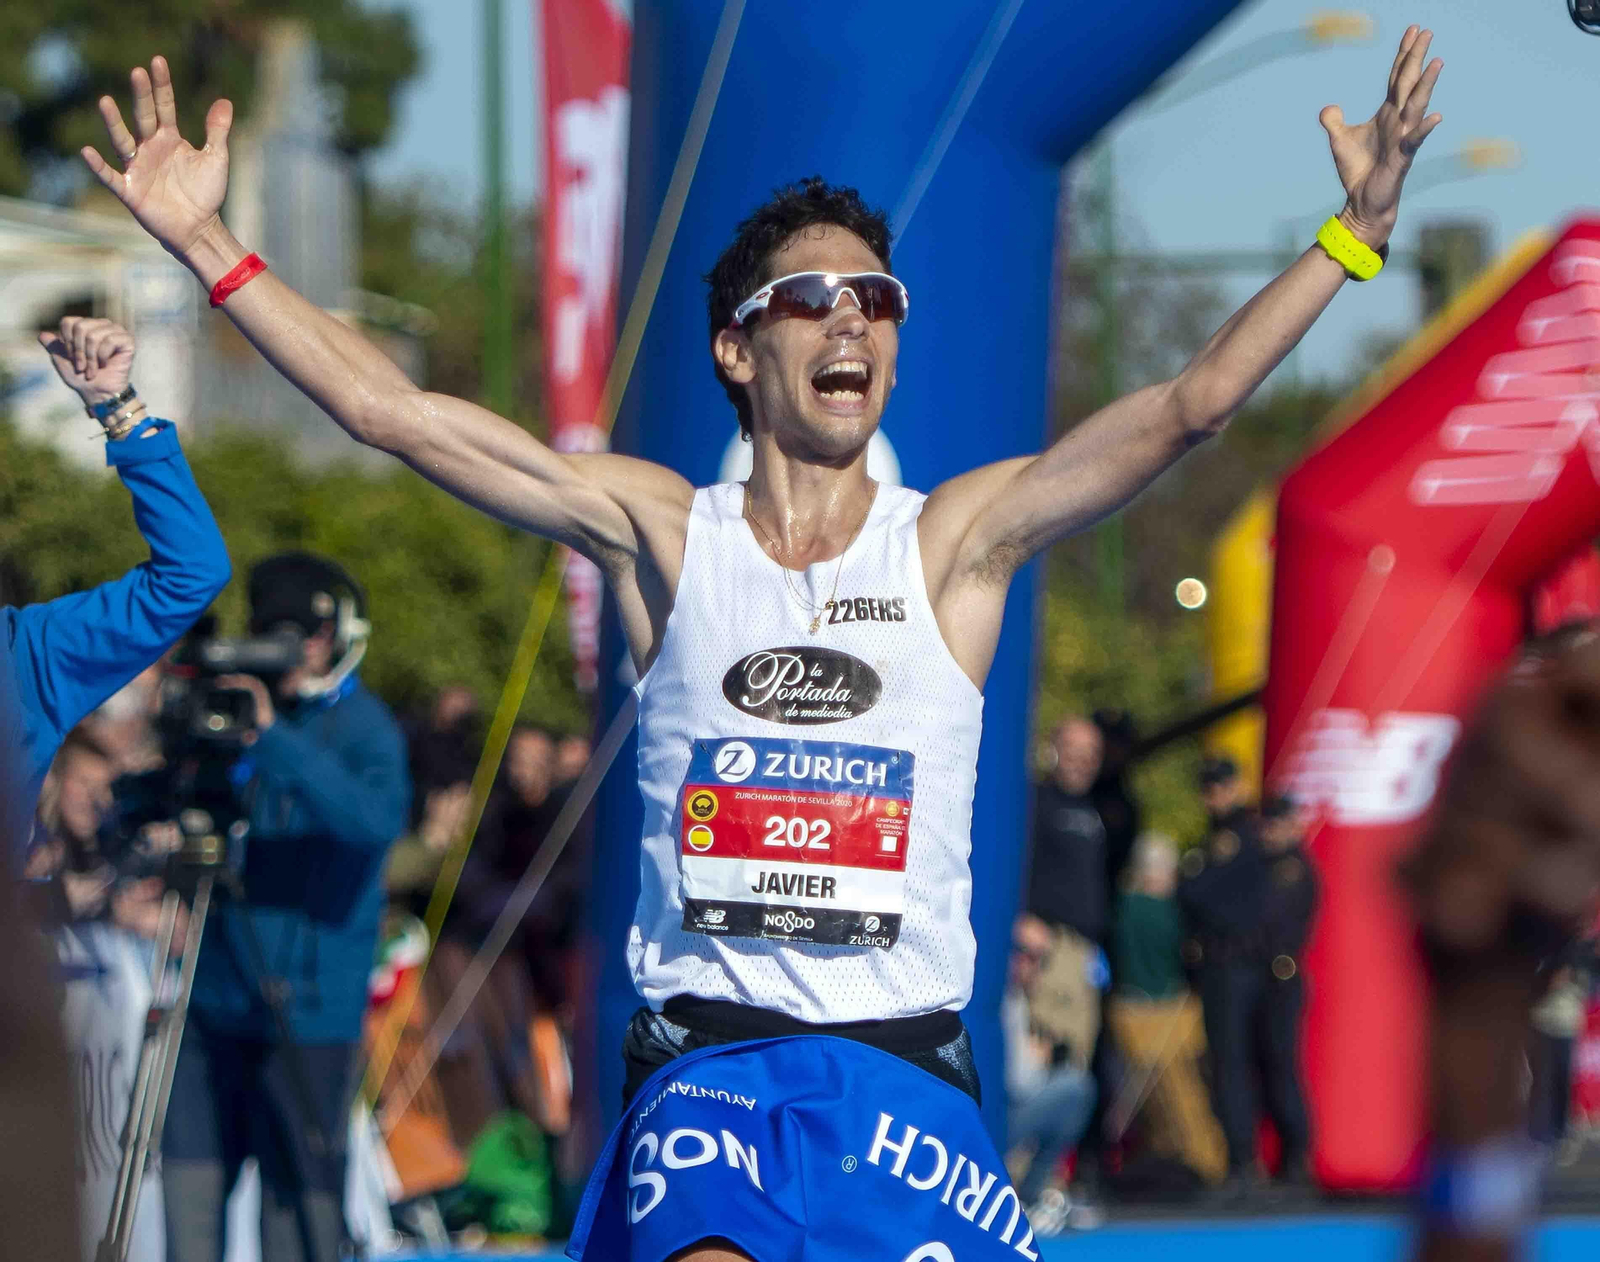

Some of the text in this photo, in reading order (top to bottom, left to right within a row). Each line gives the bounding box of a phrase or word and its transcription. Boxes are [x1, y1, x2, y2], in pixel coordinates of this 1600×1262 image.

[825, 597, 907, 625] 226ERS
[742, 651, 852, 707] Portada
[810, 663, 823, 677] la
[785, 703, 798, 717] de
[763, 753, 888, 787] ZURICH
[735, 791, 853, 807] ZURICH MARATÓN DE SEVILLA 2020
[763, 815, 832, 850] 202
[751, 871, 837, 899] JAVIER
[707, 923, 729, 931] balance
[849, 935, 890, 947] ZURICH
